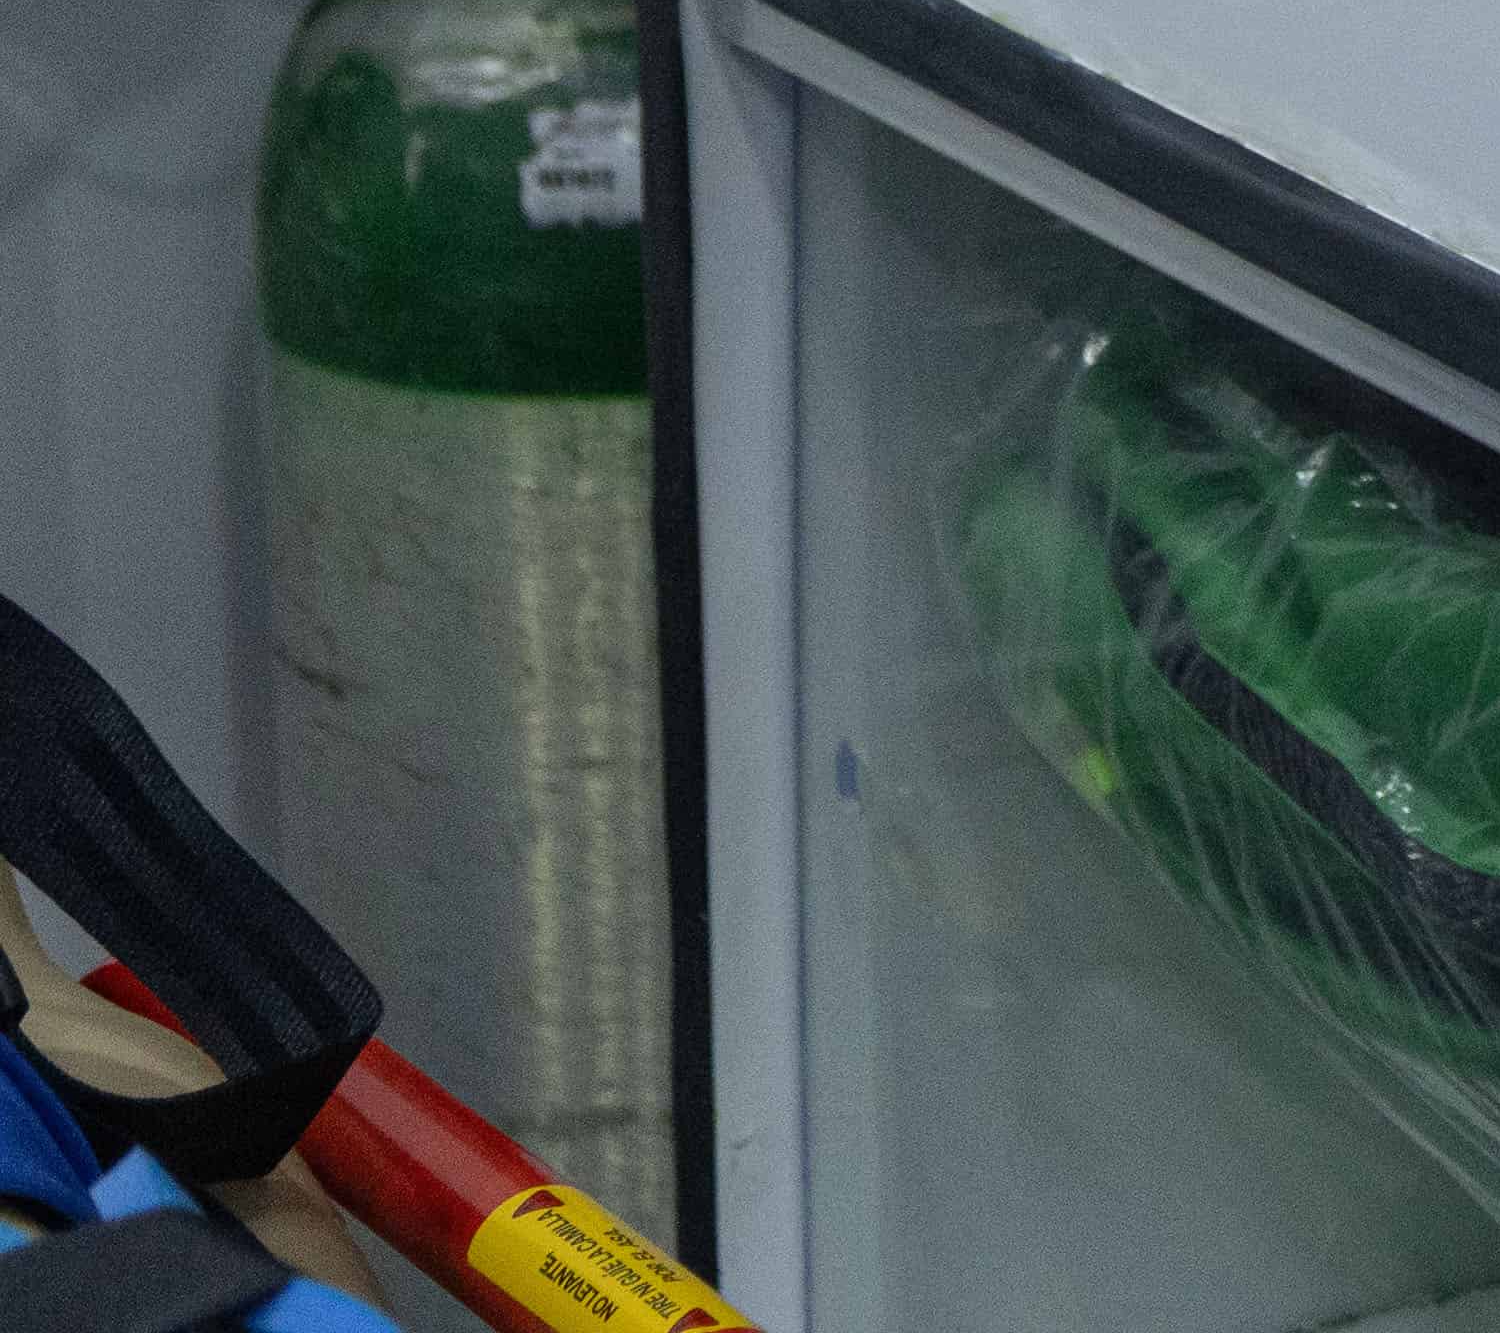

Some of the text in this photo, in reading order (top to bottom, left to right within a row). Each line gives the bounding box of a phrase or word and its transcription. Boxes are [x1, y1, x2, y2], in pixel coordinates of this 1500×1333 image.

[537, 1208, 598, 1254] CAMILLA
[593, 1245, 615, 1267] LA
[592, 1295, 621, 1323] NO
[647, 1285, 682, 1321] TIRE
